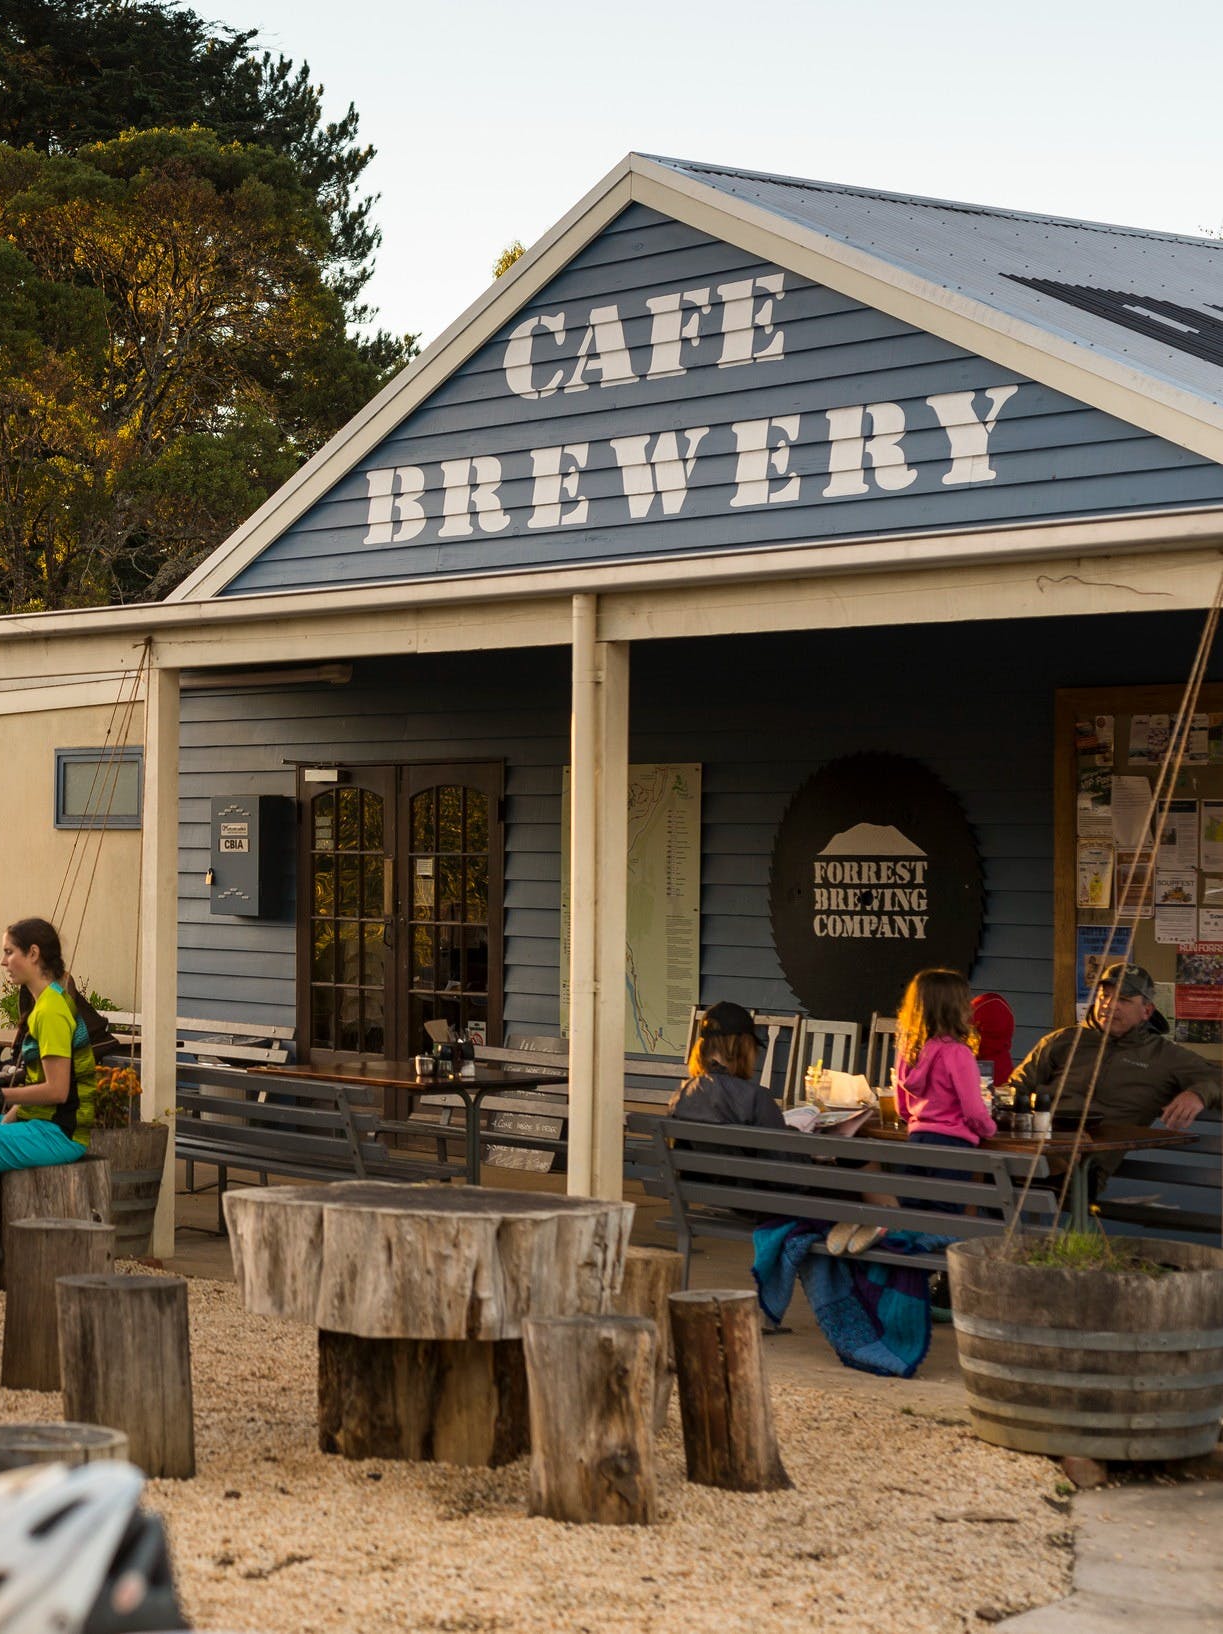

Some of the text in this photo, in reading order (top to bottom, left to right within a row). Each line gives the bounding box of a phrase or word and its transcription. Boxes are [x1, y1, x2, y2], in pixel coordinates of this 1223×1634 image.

[501, 272, 785, 400] CAFE
[362, 384, 1019, 545] BREWERY
[813, 861, 928, 884] FORREST
[813, 914, 930, 939] COMPANY
